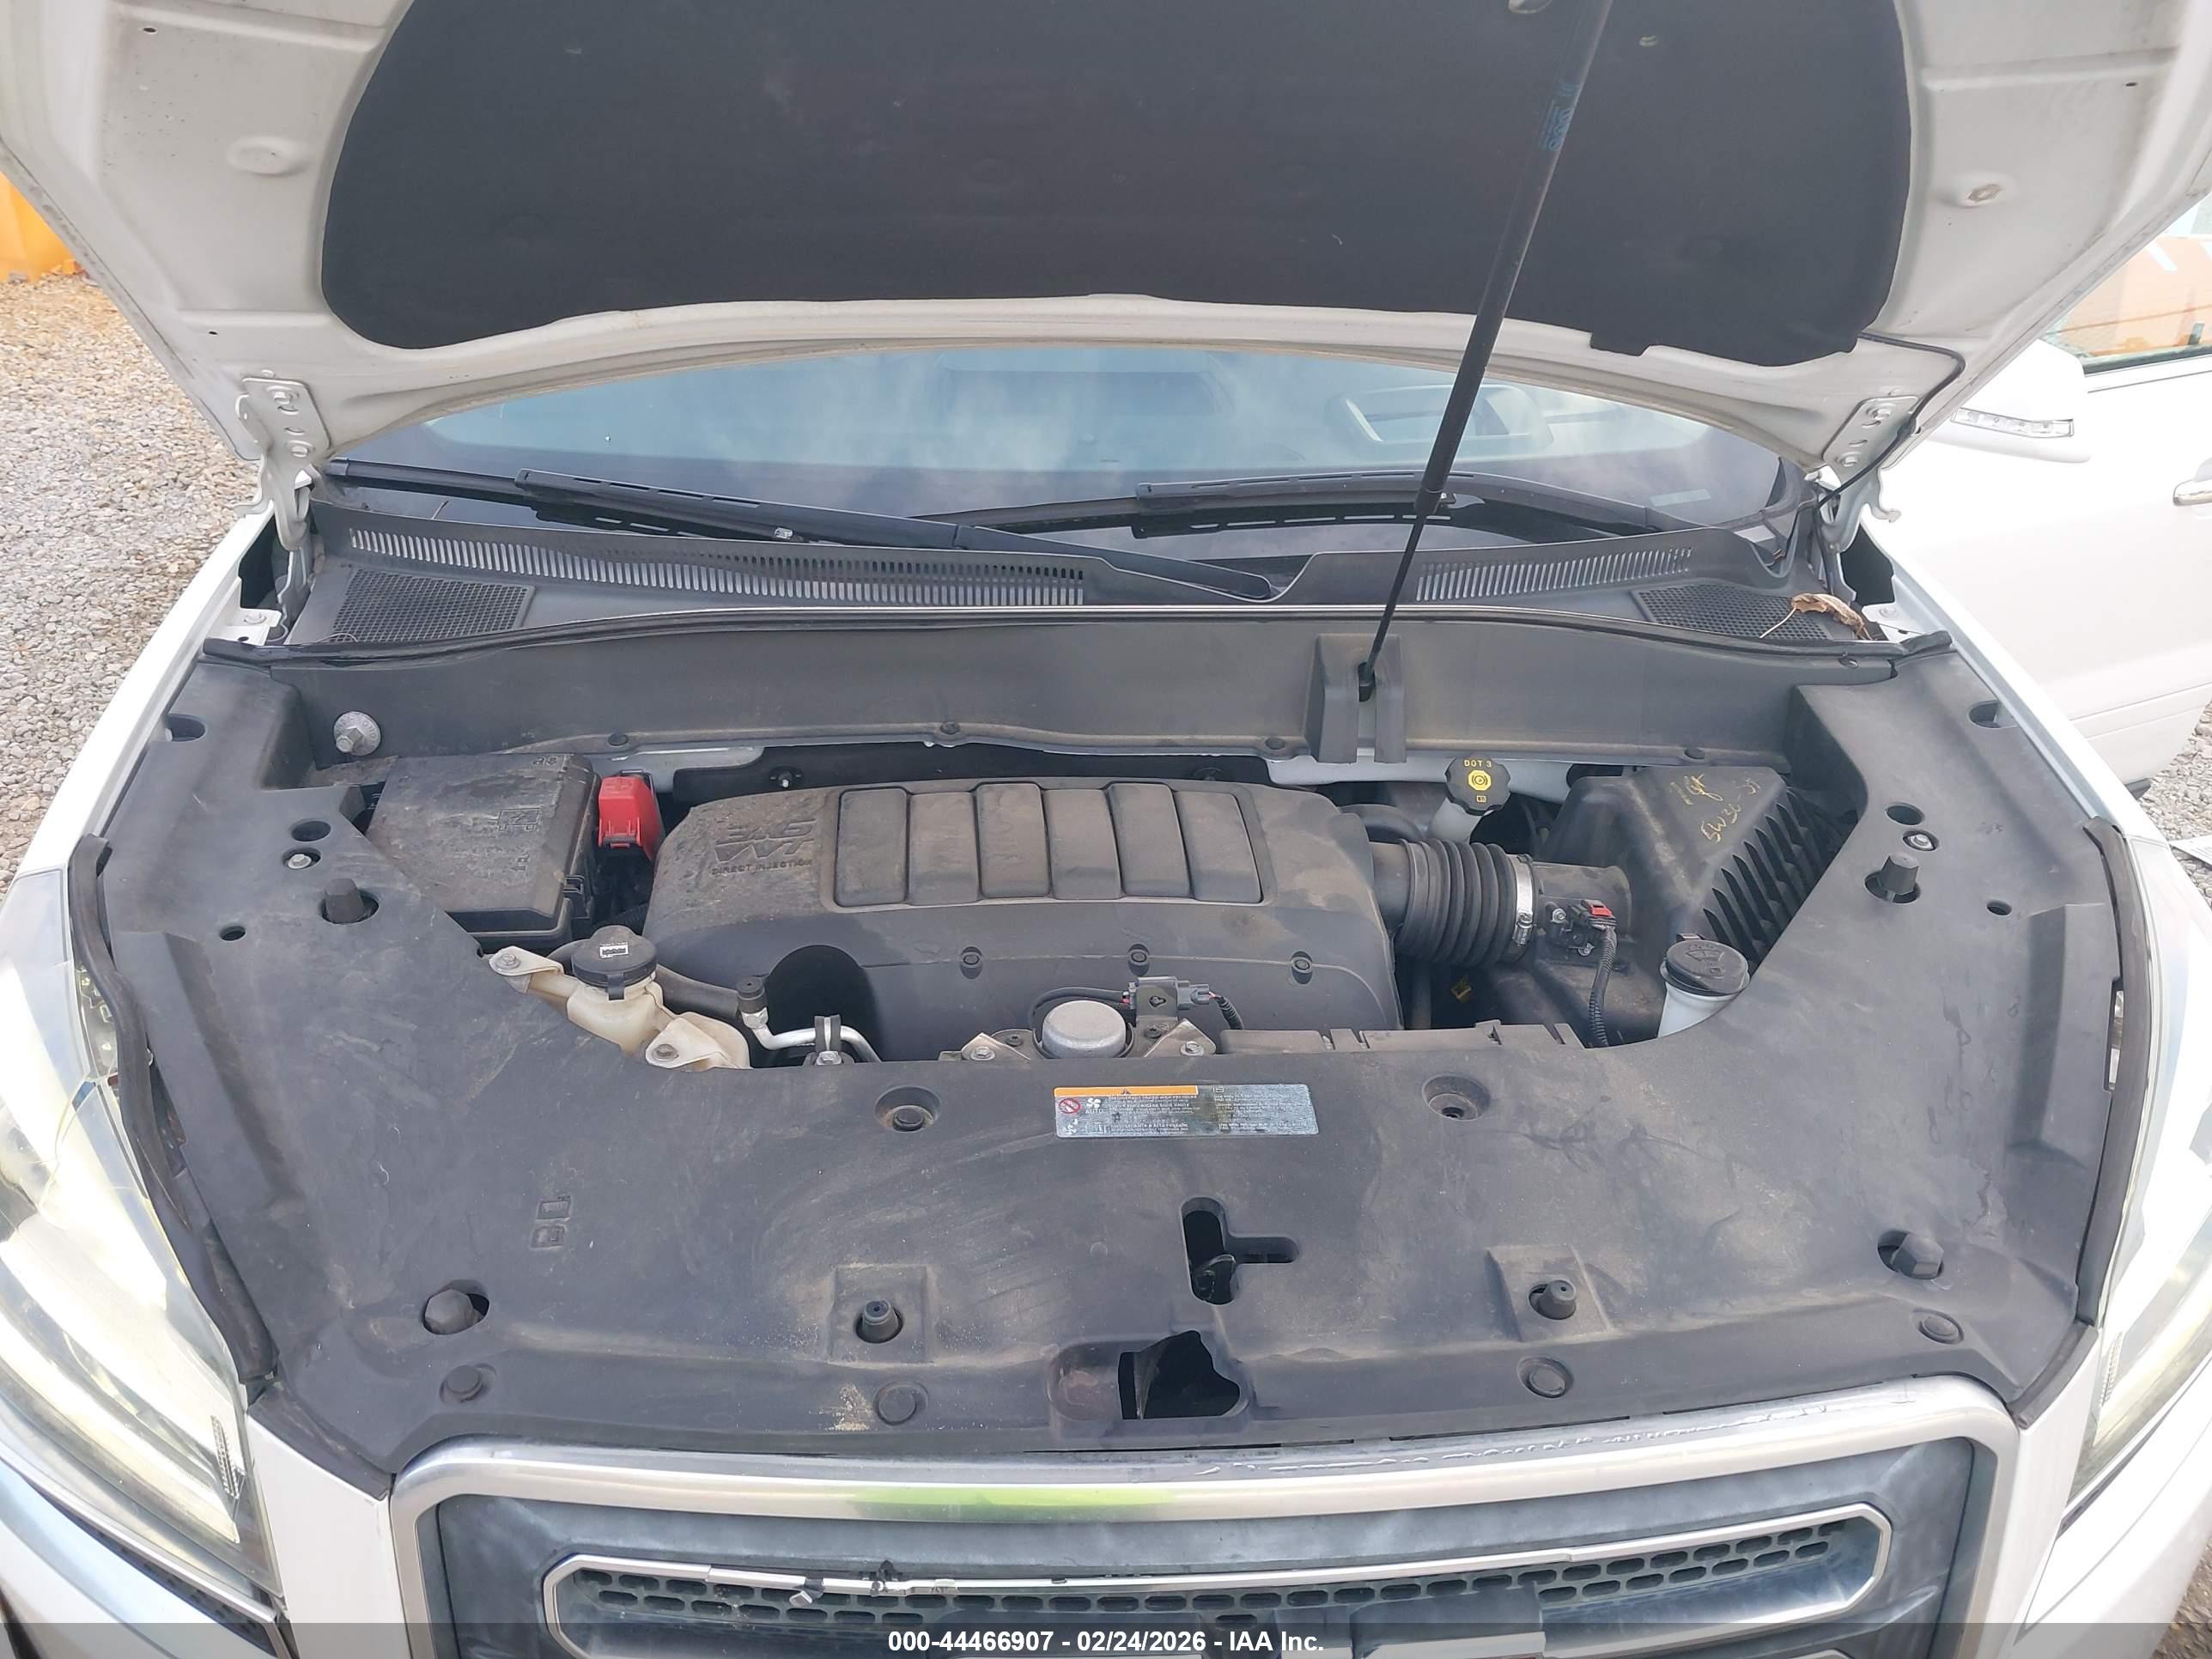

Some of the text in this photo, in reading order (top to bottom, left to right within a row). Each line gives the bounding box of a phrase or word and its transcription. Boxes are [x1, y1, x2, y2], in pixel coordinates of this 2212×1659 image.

[1463, 759, 1483, 768] DOT
[711, 858, 812, 876] DIRECT INJECTION
